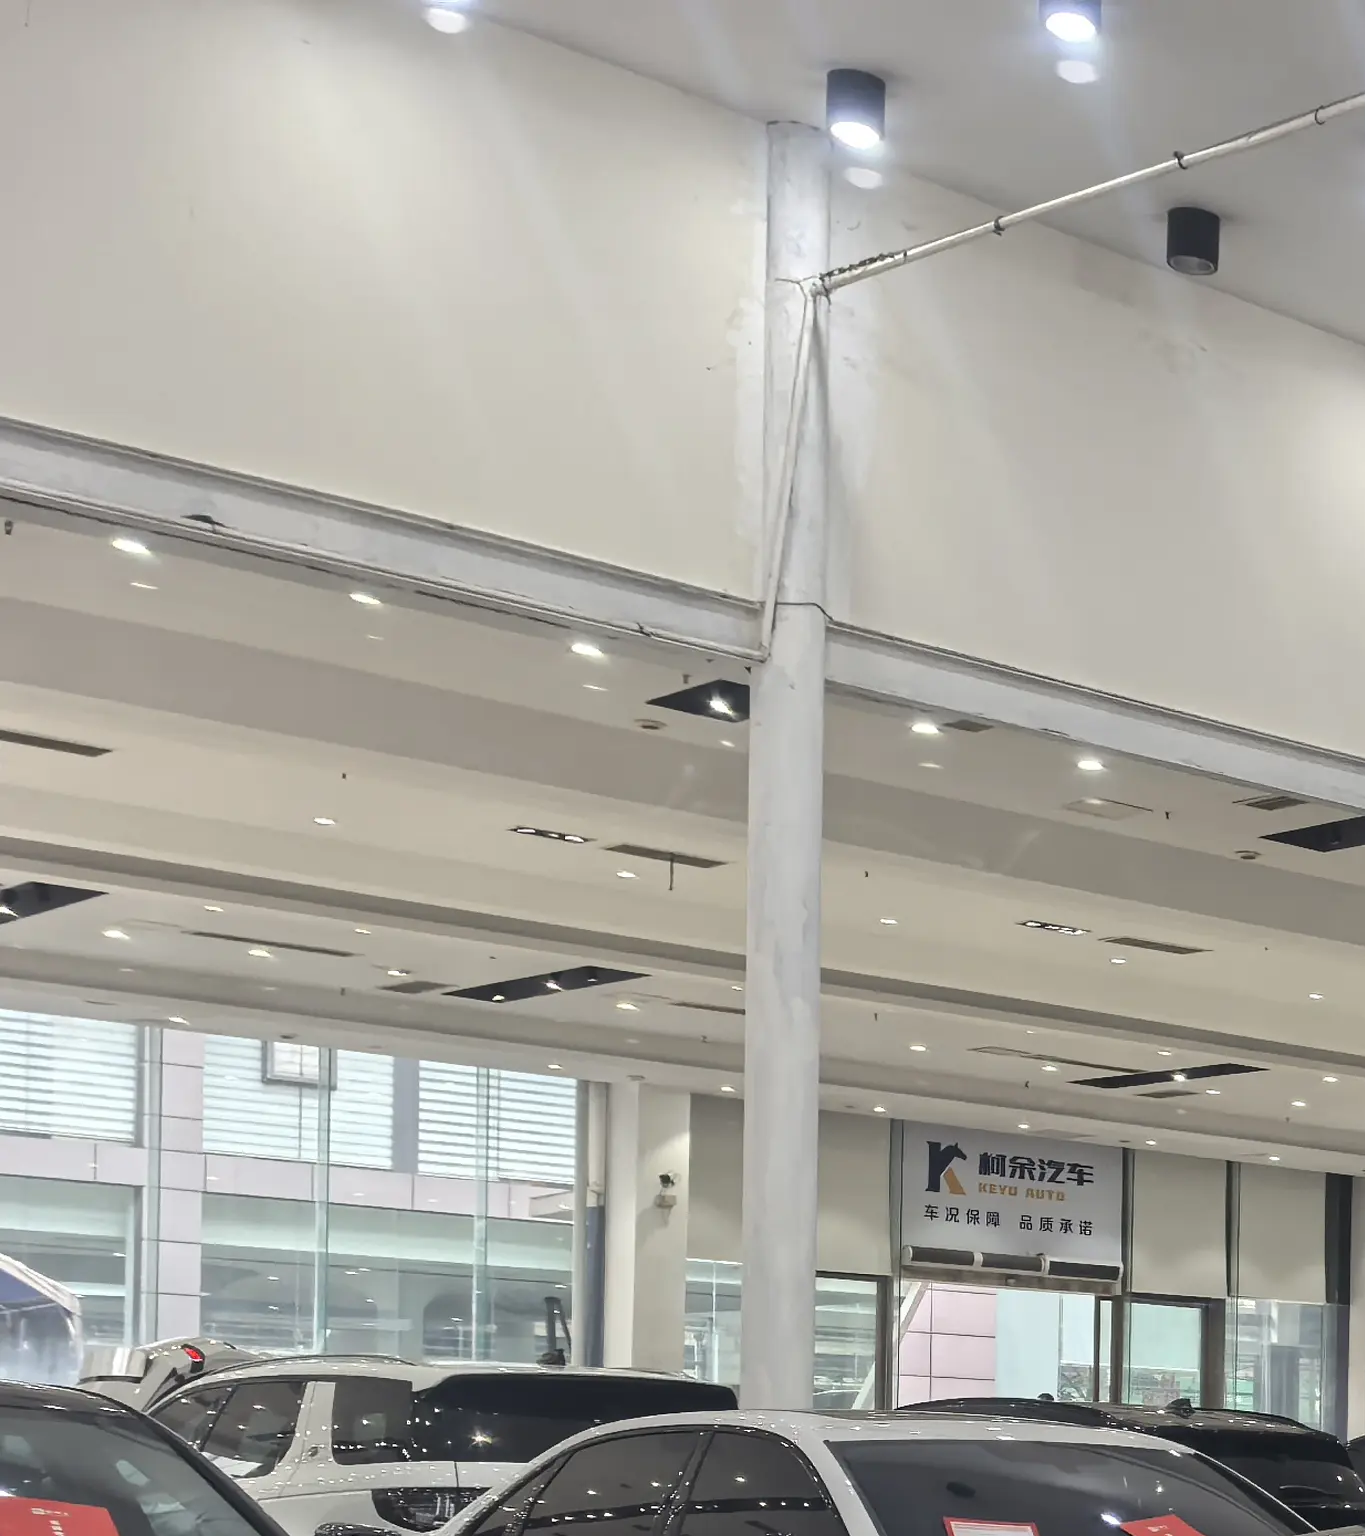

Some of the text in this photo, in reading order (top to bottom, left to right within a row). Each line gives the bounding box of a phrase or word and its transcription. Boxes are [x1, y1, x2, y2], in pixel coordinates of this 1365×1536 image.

[978, 1151, 1095, 1187] 柯余汽车
[1024, 1187, 1066, 1202] AUTO
[923, 1204, 1094, 1237] 车况保障 品质承诺
